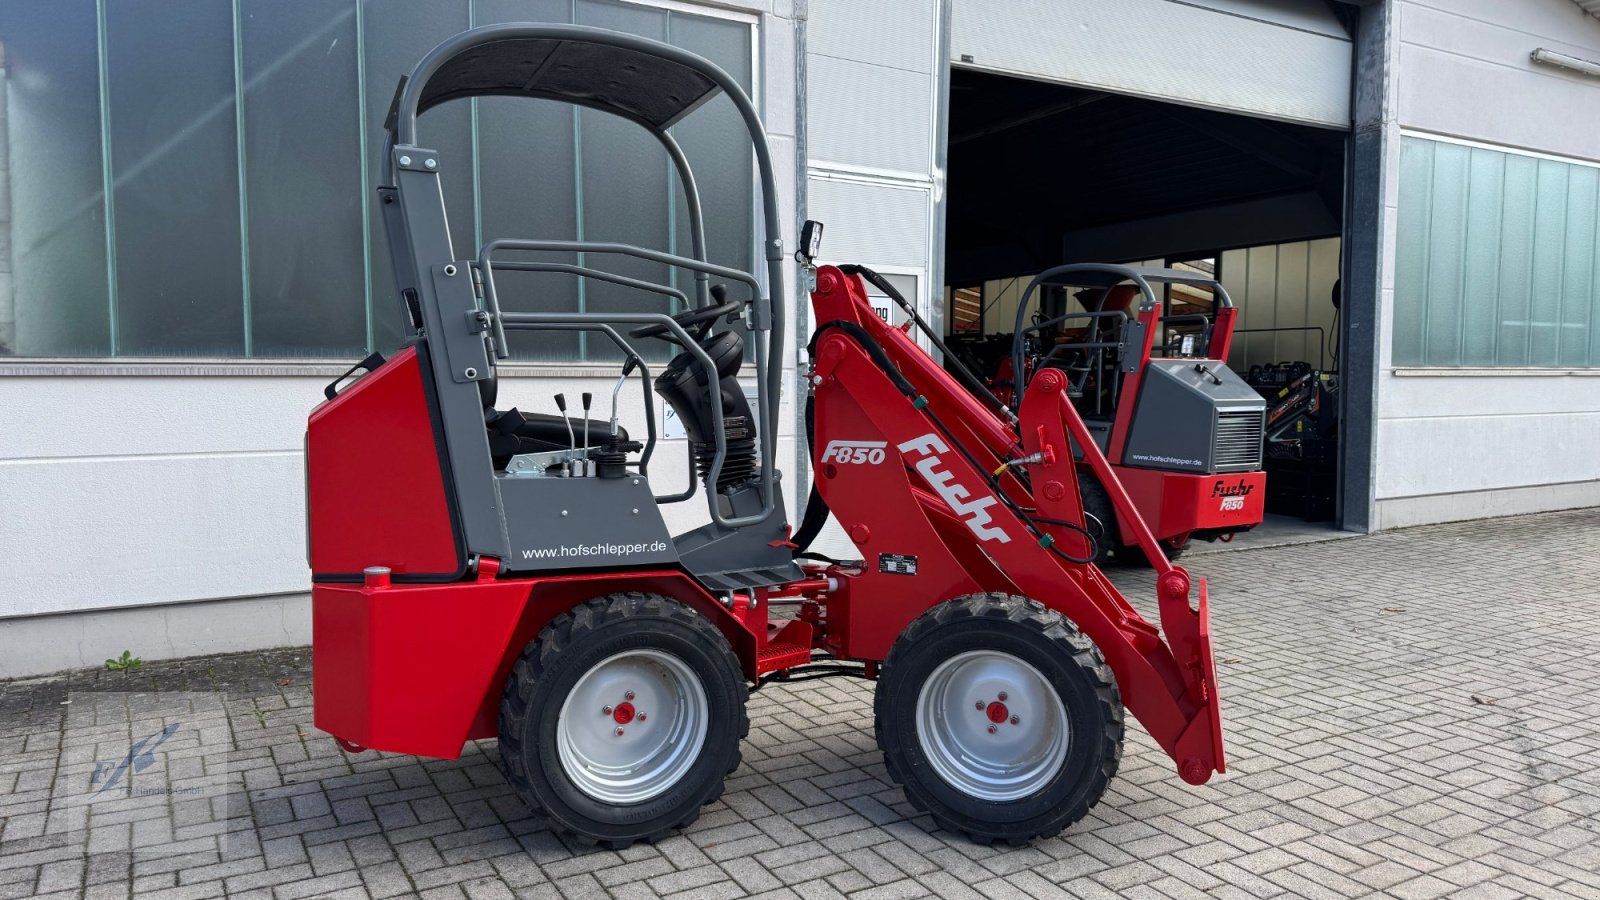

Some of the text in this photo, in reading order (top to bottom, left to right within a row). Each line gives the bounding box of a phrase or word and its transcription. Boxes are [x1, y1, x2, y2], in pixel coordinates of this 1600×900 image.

[821, 440, 888, 464] F850
[1132, 454, 1202, 466] www.hofschlepper.de
[896, 433, 1012, 544] Fuchs
[1211, 479, 1254, 498] Fuchs
[1219, 496, 1244, 511] F850
[521, 540, 667, 559] www.hofschlepper.de
